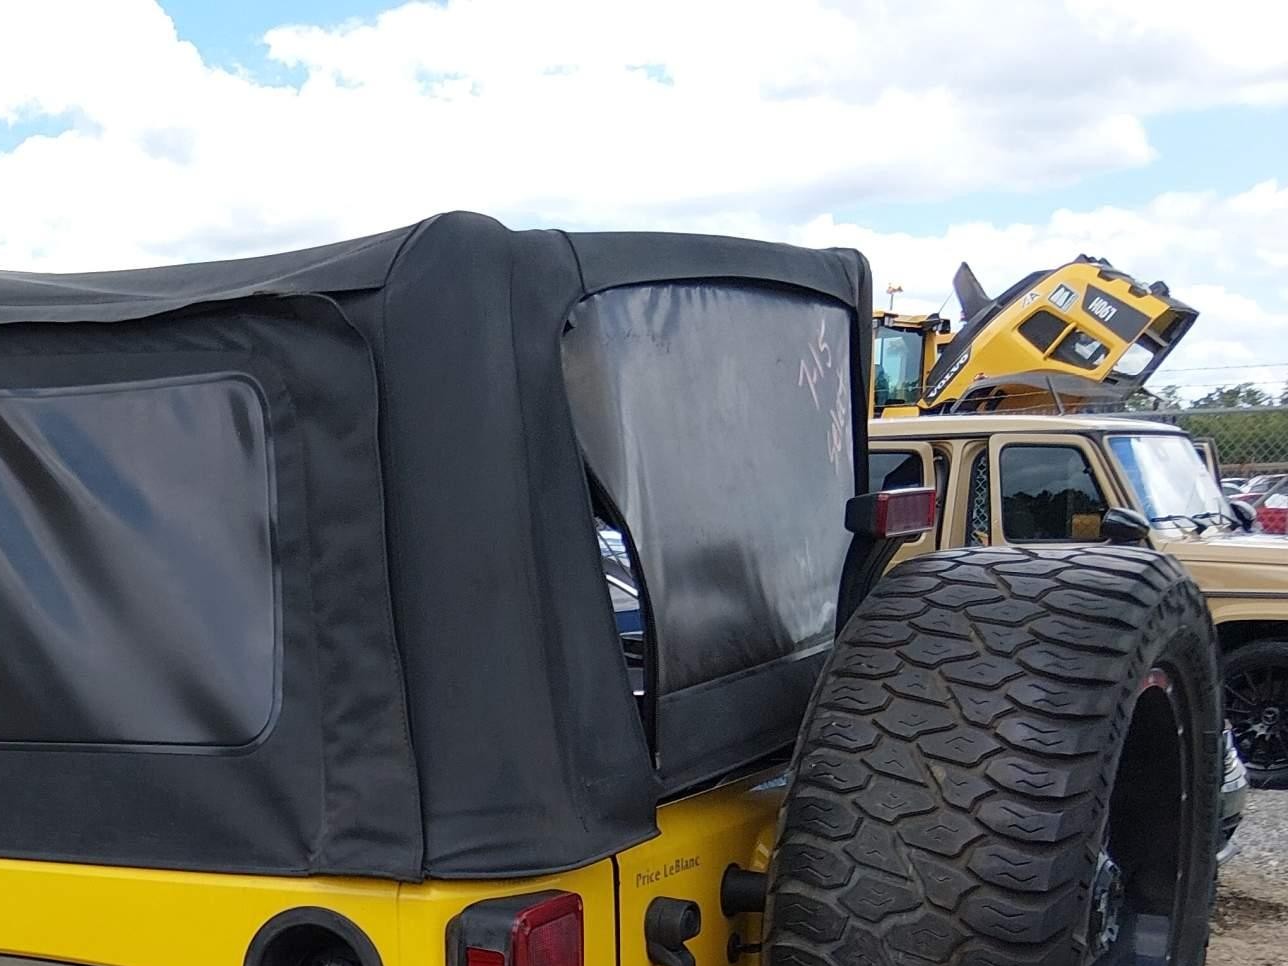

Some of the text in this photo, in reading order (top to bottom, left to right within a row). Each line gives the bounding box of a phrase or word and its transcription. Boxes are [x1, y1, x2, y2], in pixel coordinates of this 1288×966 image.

[927, 353, 969, 398] VOLVO
[635, 856, 701, 888] Price LeBlanc
